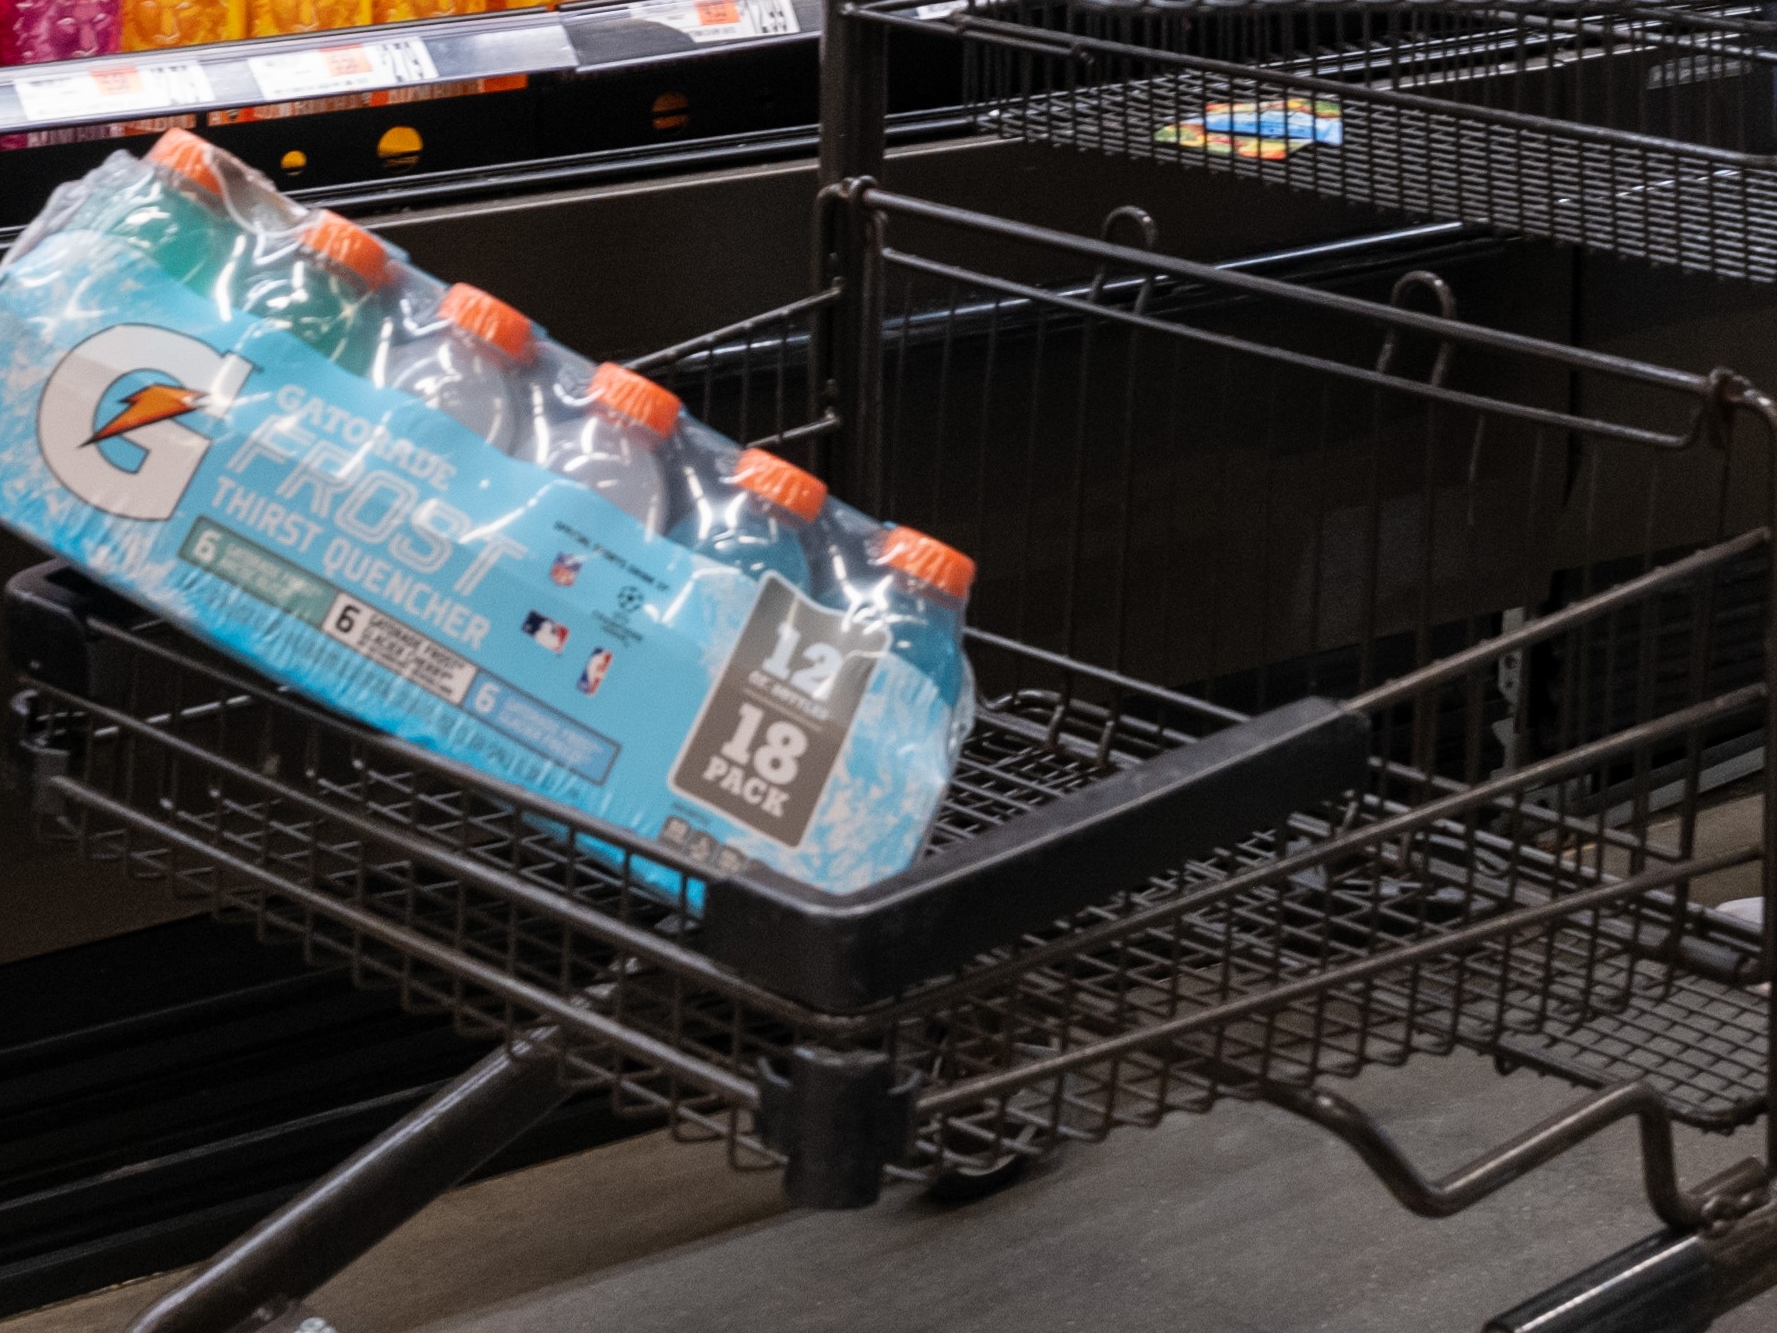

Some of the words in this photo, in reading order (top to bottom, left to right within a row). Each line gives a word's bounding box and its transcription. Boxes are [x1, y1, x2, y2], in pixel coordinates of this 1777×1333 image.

[36, 321, 262, 522] G
[275, 383, 457, 493] GATORADE
[193, 529, 217, 562] 6
[226, 416, 531, 598] FROST
[207, 476, 325, 555] THIRST
[325, 539, 491, 651] QUENCHER
[335, 604, 360, 634] 6
[473, 682, 500, 714] 6
[761, 622, 844, 700] 12
[721, 702, 808, 786] 18
[702, 755, 791, 819] PACK
